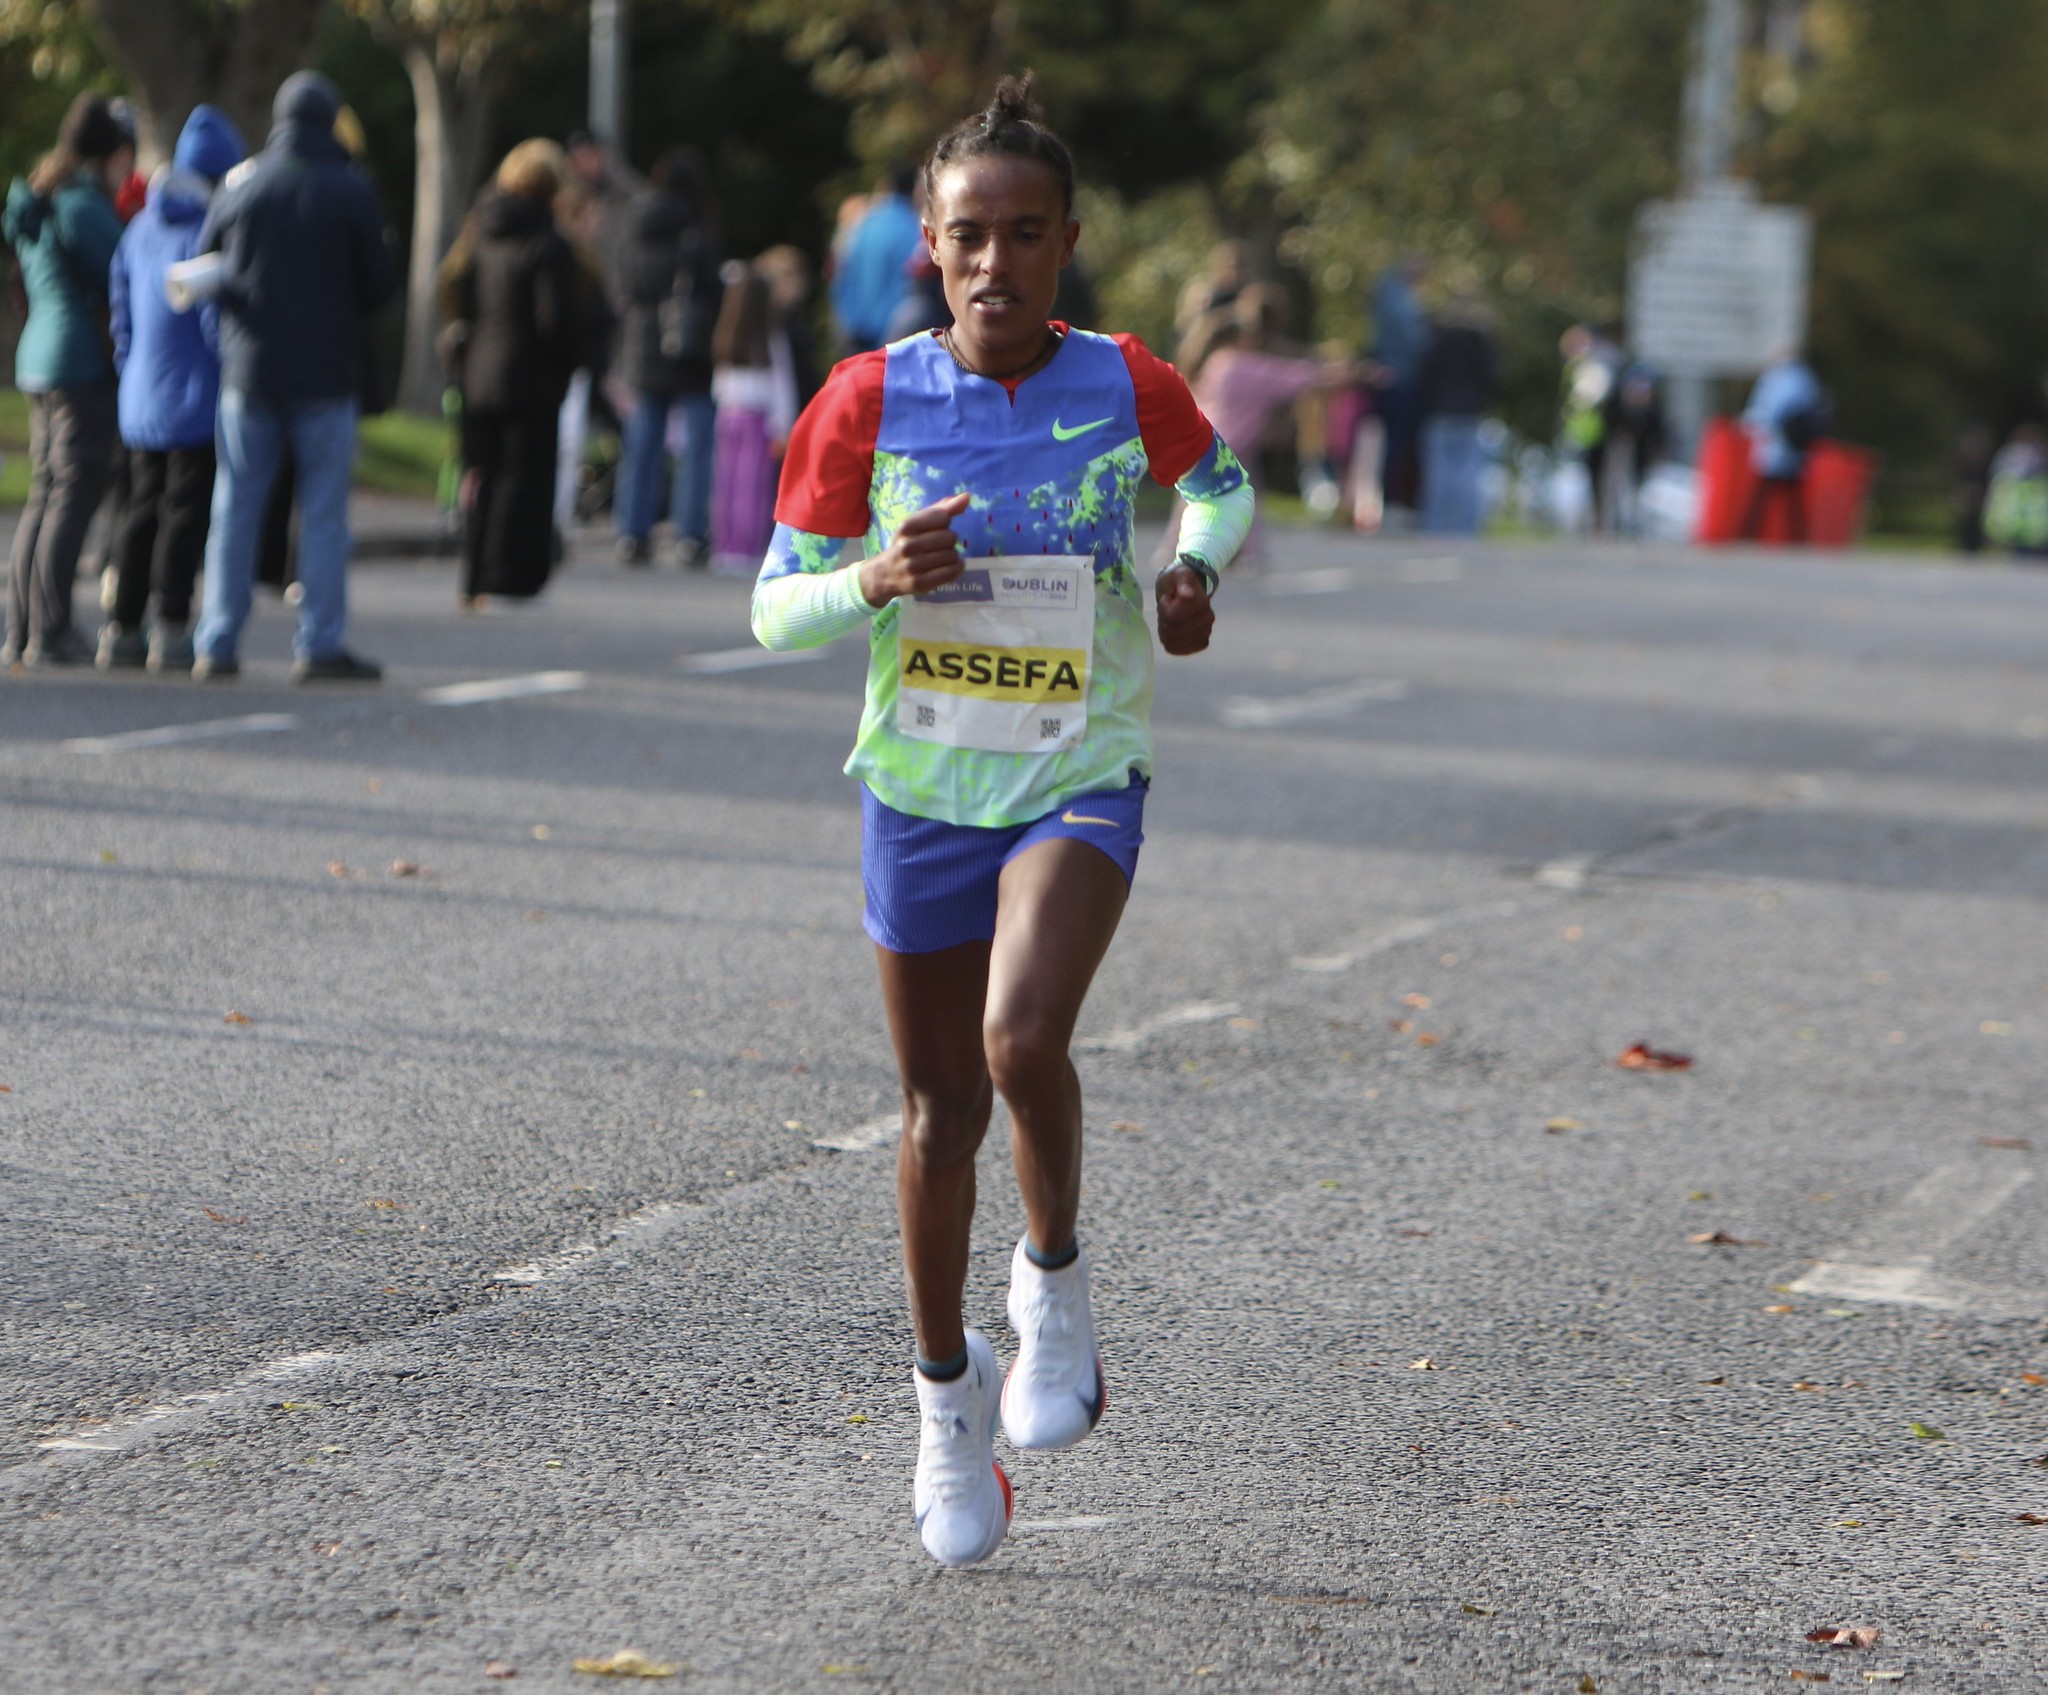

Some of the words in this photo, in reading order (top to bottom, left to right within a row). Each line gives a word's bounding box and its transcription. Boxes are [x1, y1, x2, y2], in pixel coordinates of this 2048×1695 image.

[962, 581, 983, 593] Life
[1002, 577, 1068, 592] DUBLIN
[904, 649, 1079, 690] ASSEFA
